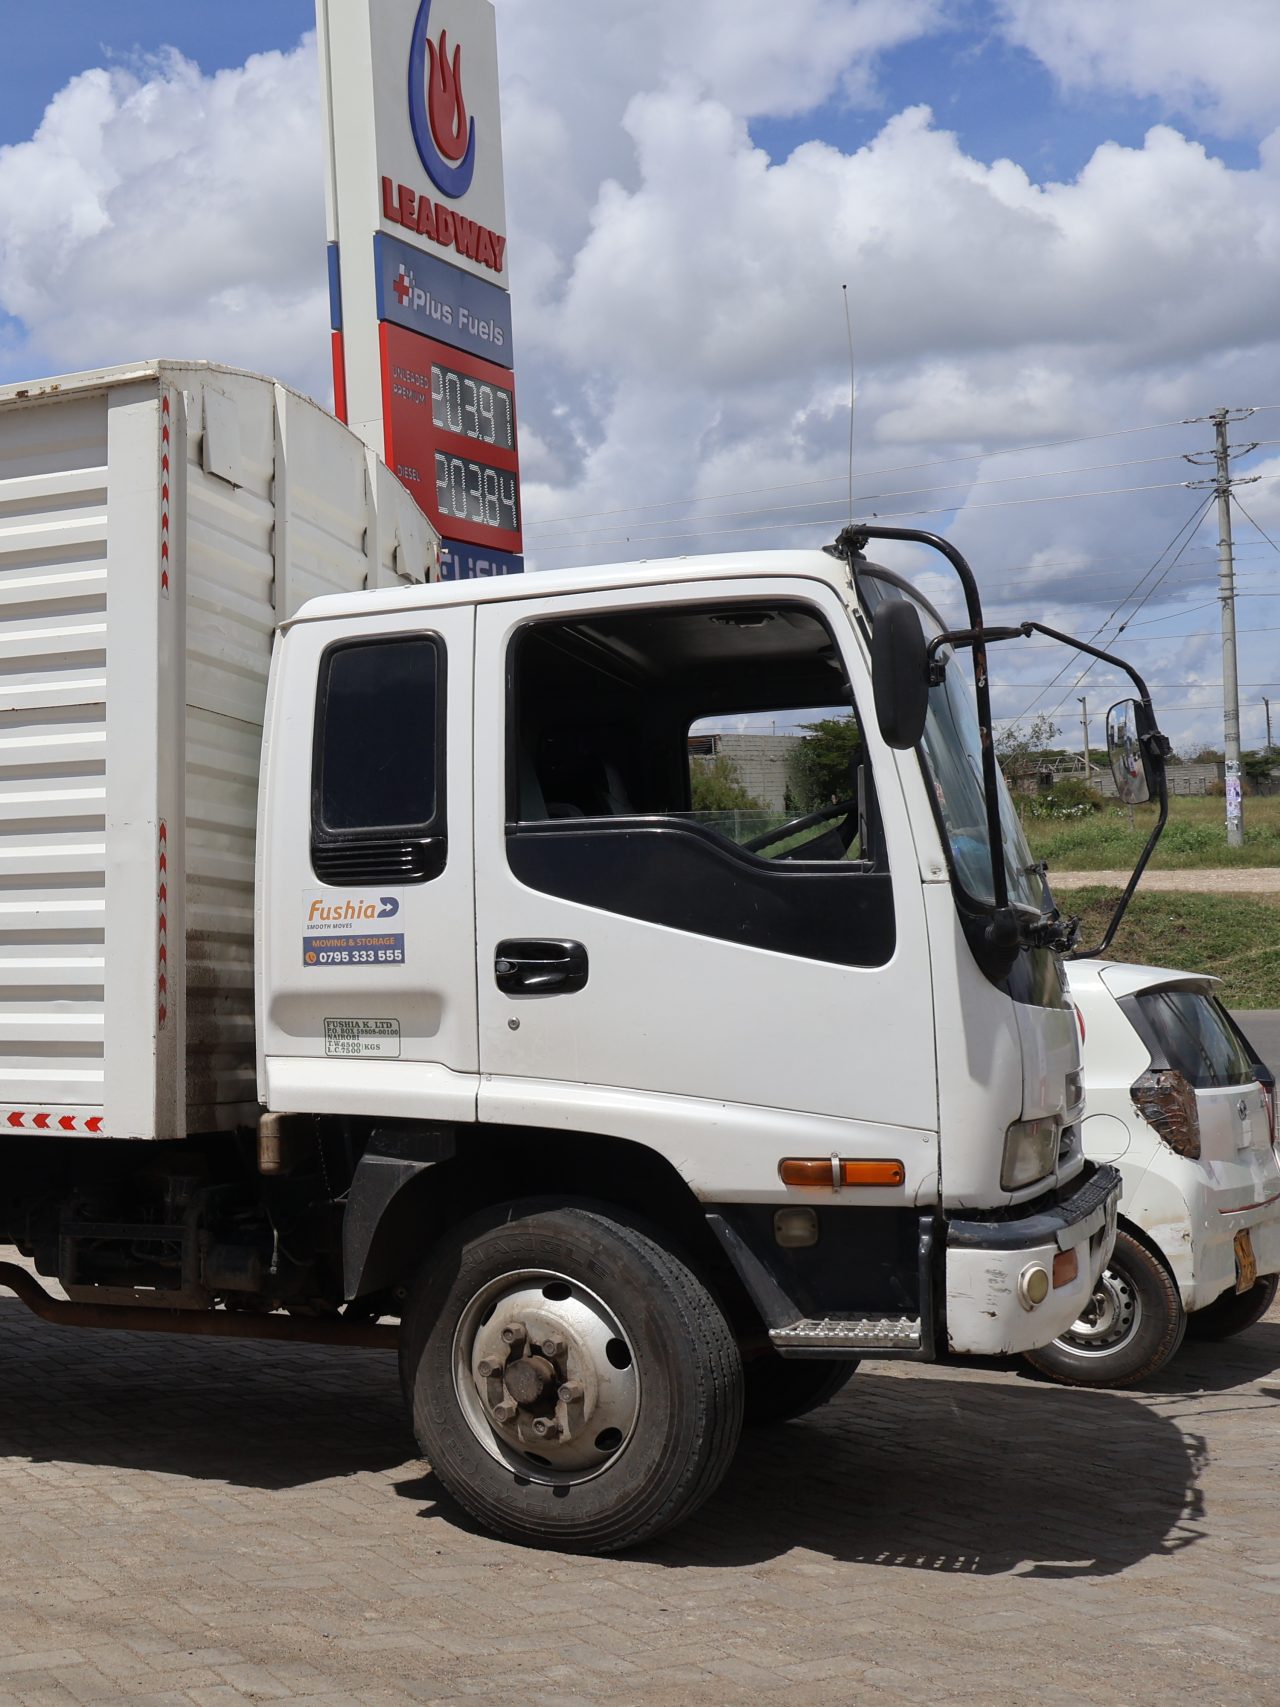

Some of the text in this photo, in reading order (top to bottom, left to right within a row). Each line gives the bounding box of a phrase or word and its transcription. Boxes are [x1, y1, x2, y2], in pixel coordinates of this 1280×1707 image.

[382, 175, 507, 273] LEADWAY
[412, 288, 505, 346] Plus Fuels
[393, 367, 429, 389] UNLEADED
[393, 383, 426, 404] PREMIUM
[397, 465, 421, 482] DIESEL
[312, 936, 396, 948] MOVING & STORAGE
[319, 949, 402, 963] 0795 333 555
[326, 1020, 360, 1029] FUSHIA
[375, 1021, 393, 1029] LTD
[364, 1043, 381, 1051] KGS
